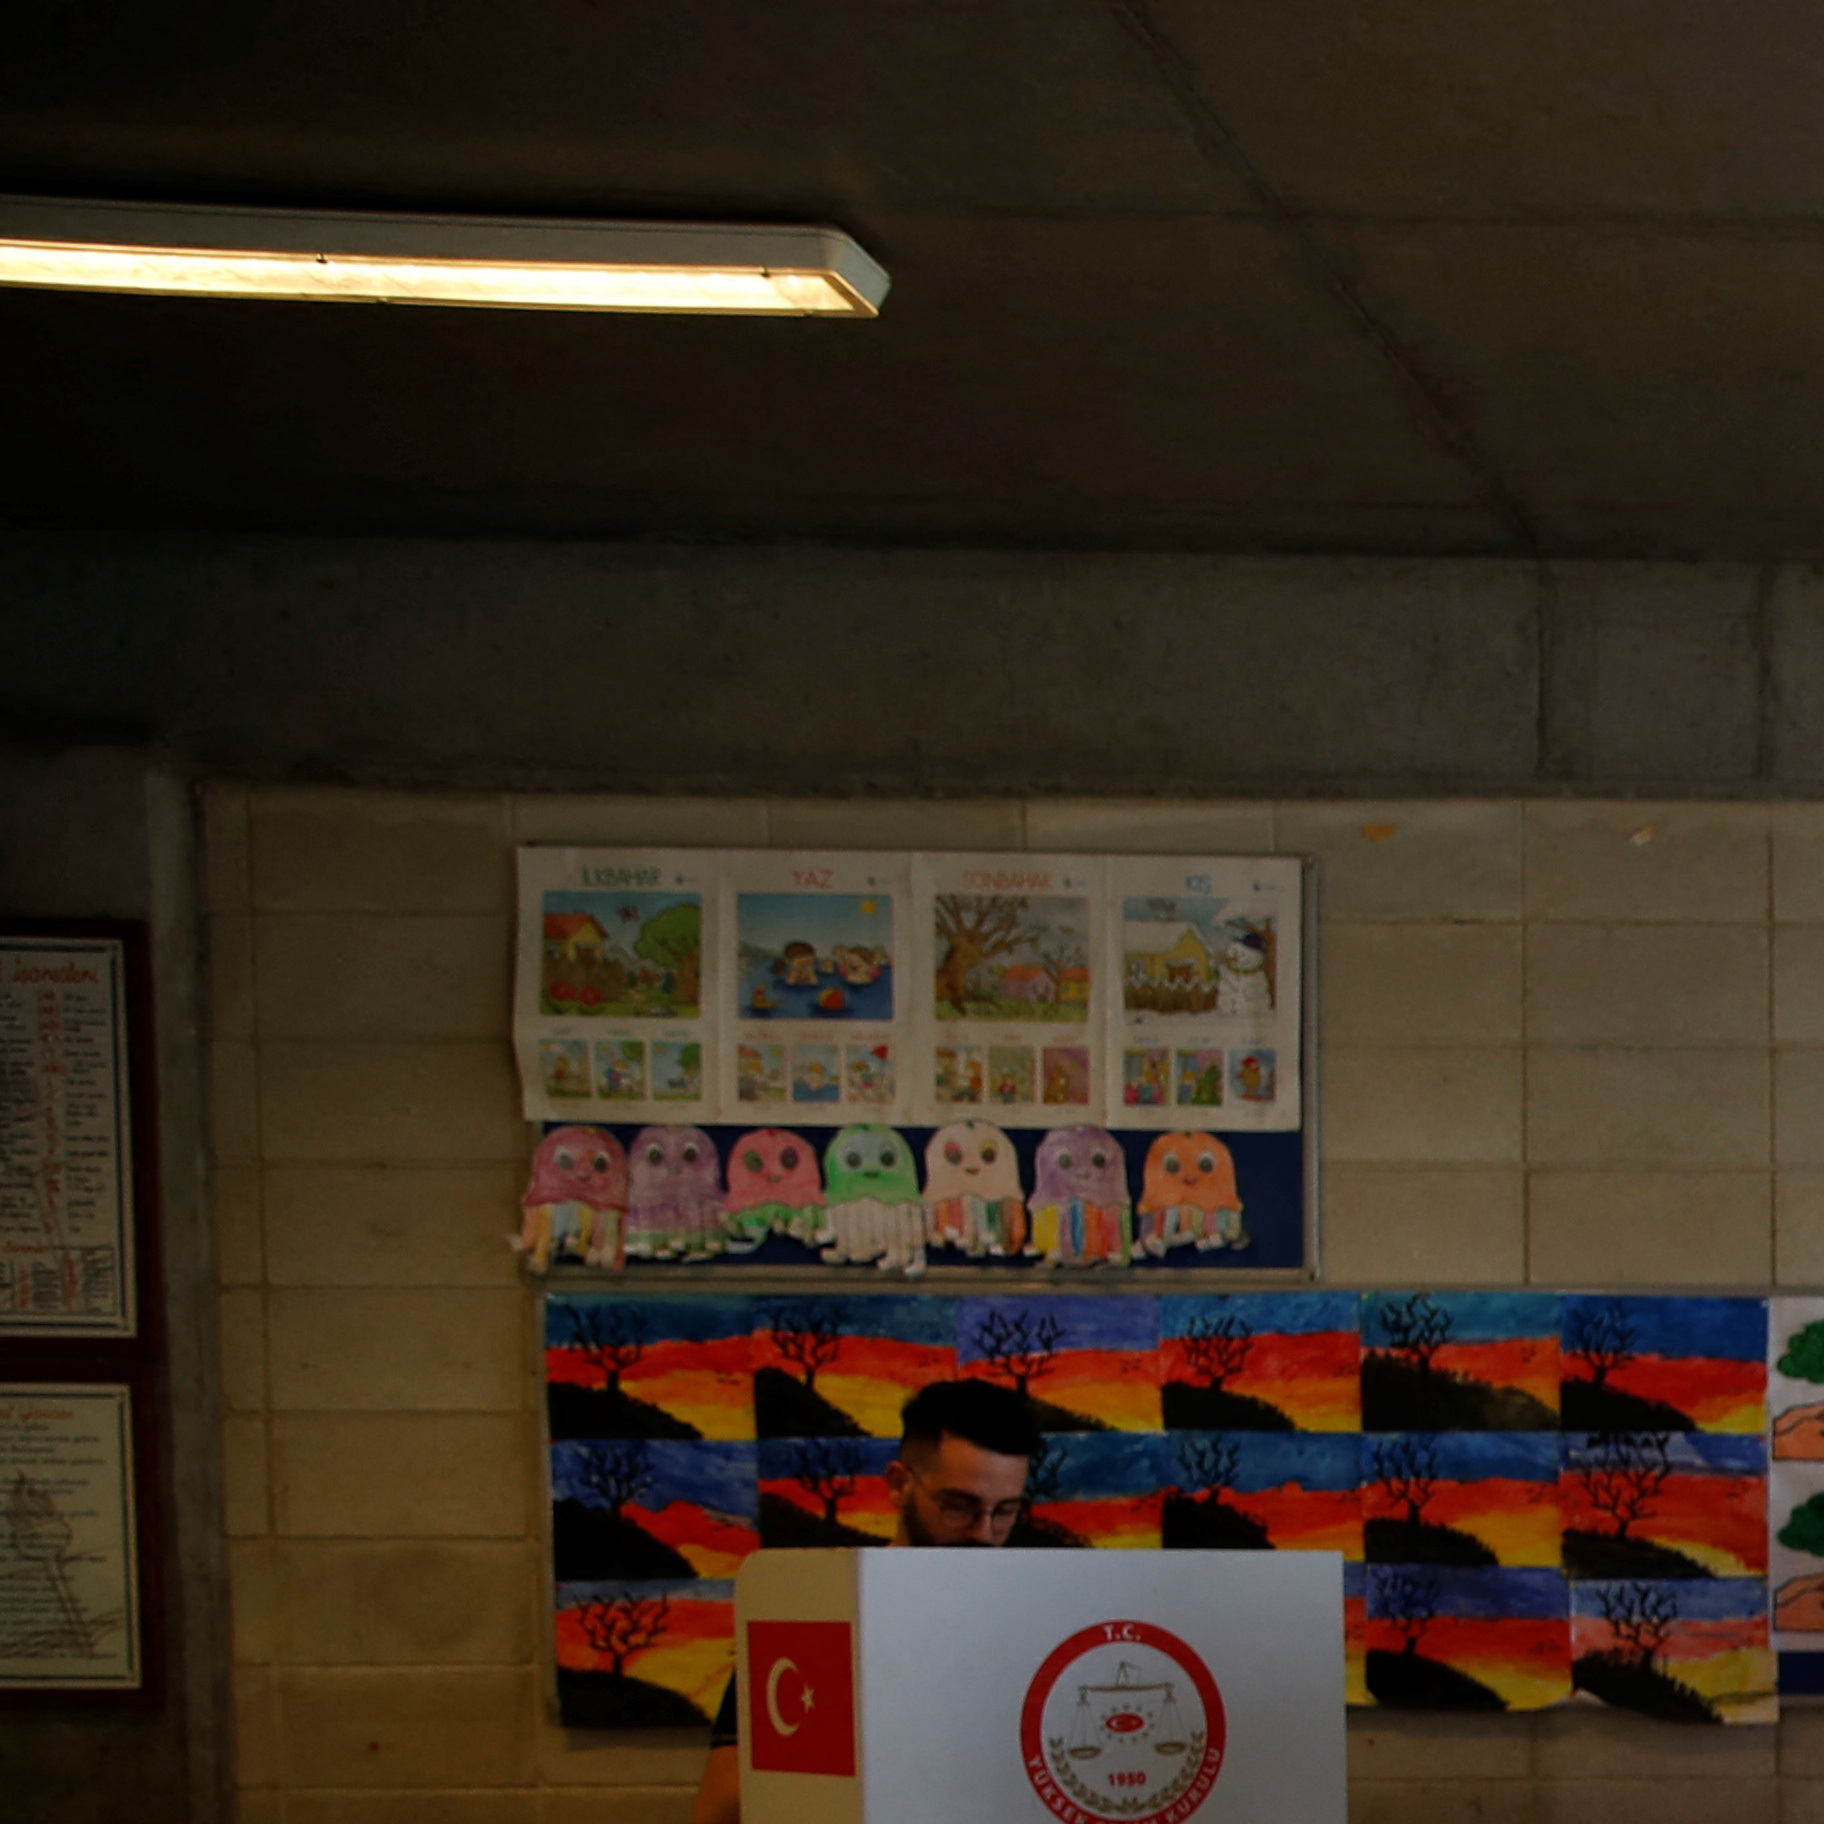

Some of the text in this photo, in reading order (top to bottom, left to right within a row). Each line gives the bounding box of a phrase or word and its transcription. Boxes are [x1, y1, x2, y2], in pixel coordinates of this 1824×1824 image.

[793, 868, 834, 889] YAZ
[1102, 1623, 1141, 1641] T.C.
[1107, 1770, 1147, 1787] 1950
[1163, 1748, 1223, 1824] KURULU
